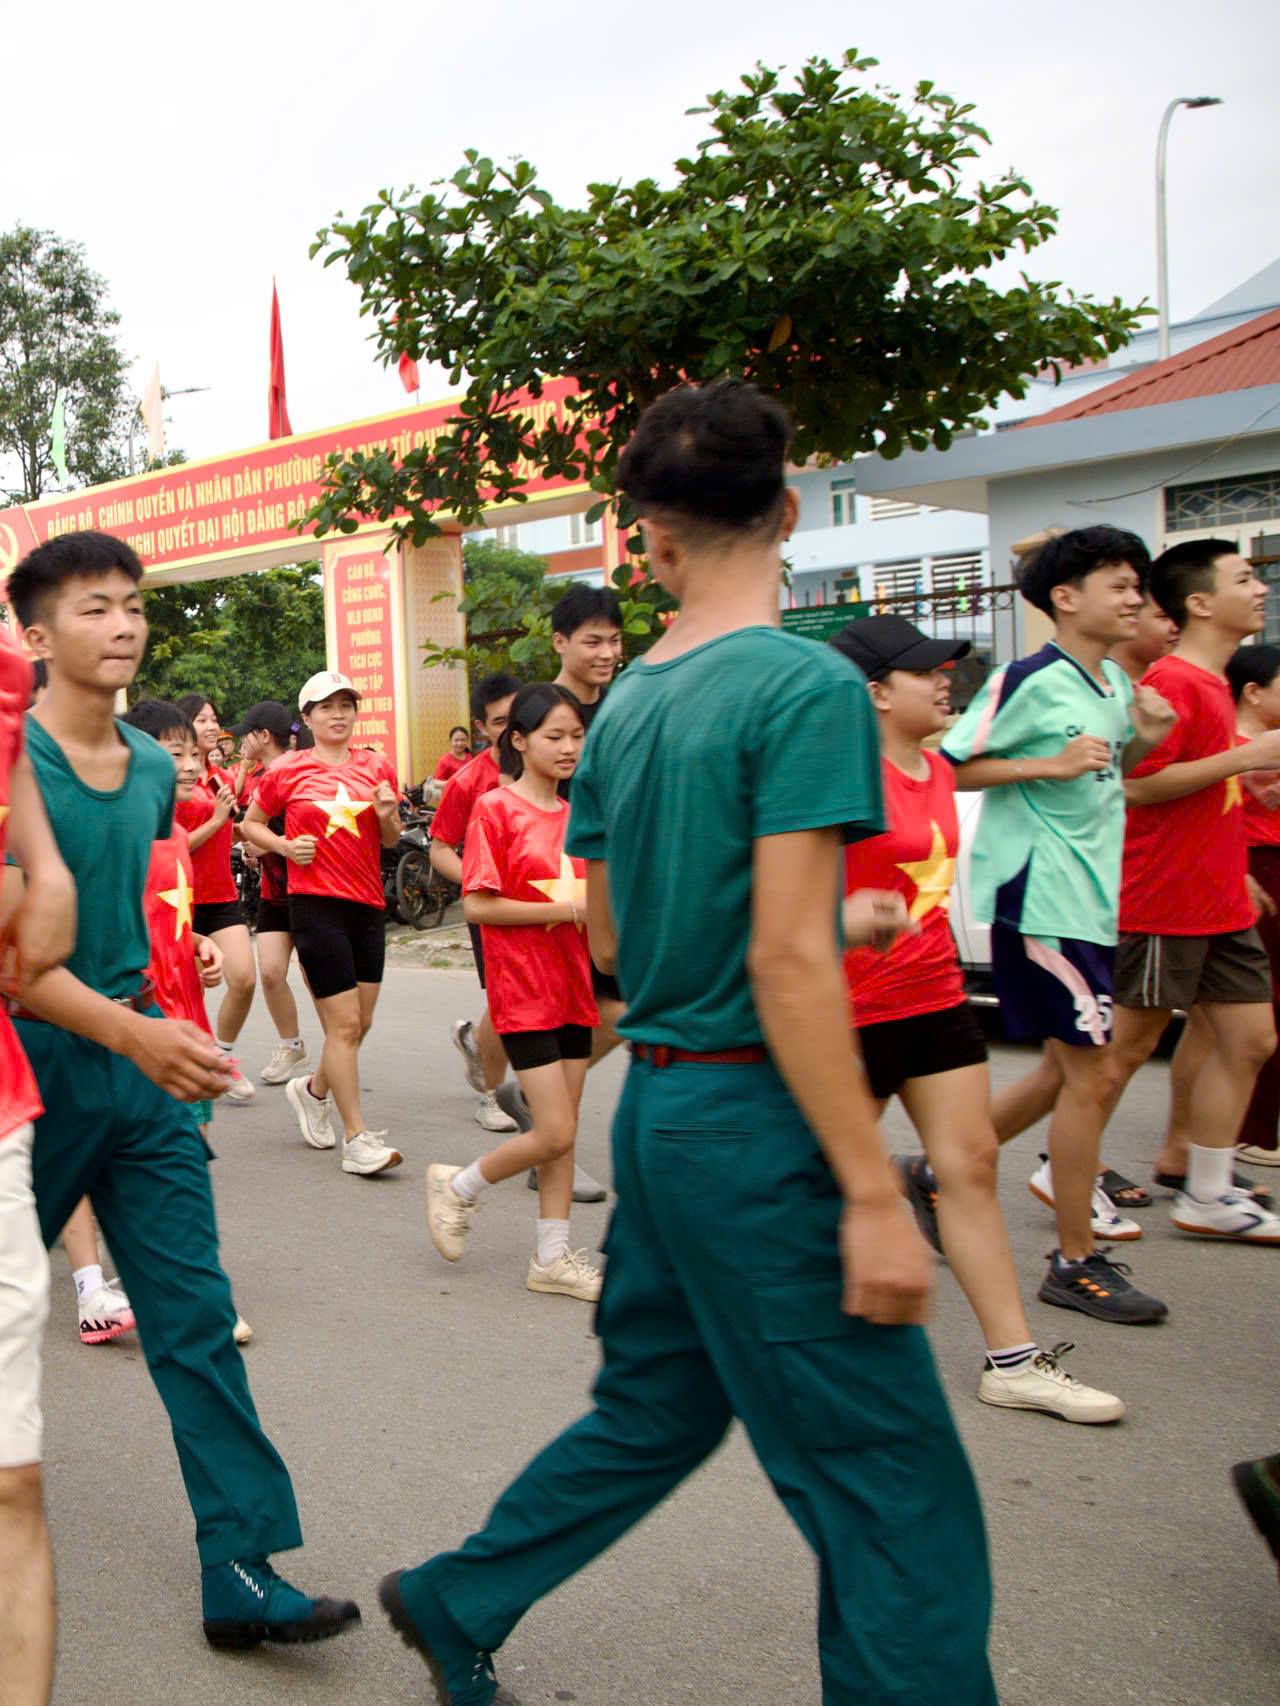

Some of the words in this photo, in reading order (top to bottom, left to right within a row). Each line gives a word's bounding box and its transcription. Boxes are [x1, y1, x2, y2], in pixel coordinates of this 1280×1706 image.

[98, 499, 134, 530] CHÍNH
[176, 481, 194, 512] VÀ
[196, 474, 232, 506] NHÂN
[234, 466, 262, 498] DÂN
[264, 454, 322, 491] PHƯỜNG
[158, 515, 195, 555] QUYẾT
[197, 516, 220, 547] ĐẠI
[222, 507, 245, 543] HỘI
[247, 499, 285, 533] ĐẢNG
[374, 696, 392, 712] THEO
